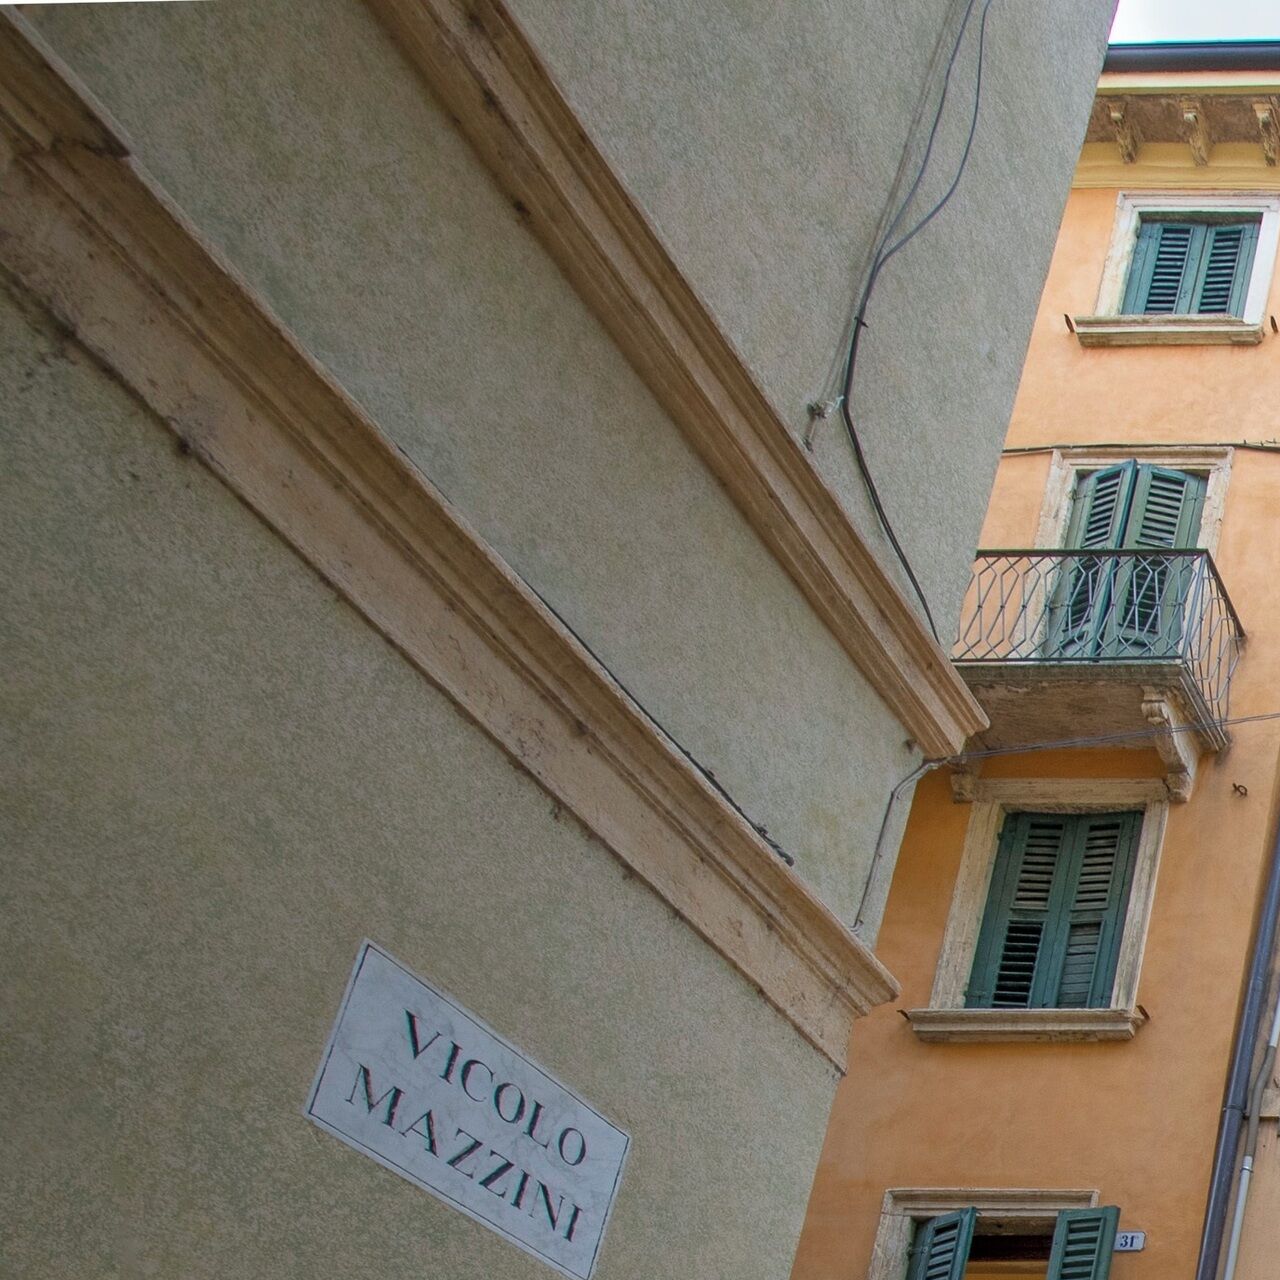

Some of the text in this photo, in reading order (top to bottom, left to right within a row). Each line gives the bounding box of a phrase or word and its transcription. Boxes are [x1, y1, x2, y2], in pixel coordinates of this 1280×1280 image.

[345, 1063, 582, 1242] MAZZINI
[404, 1008, 586, 1166] VICOLO
[1120, 1235, 1134, 1248] 31
